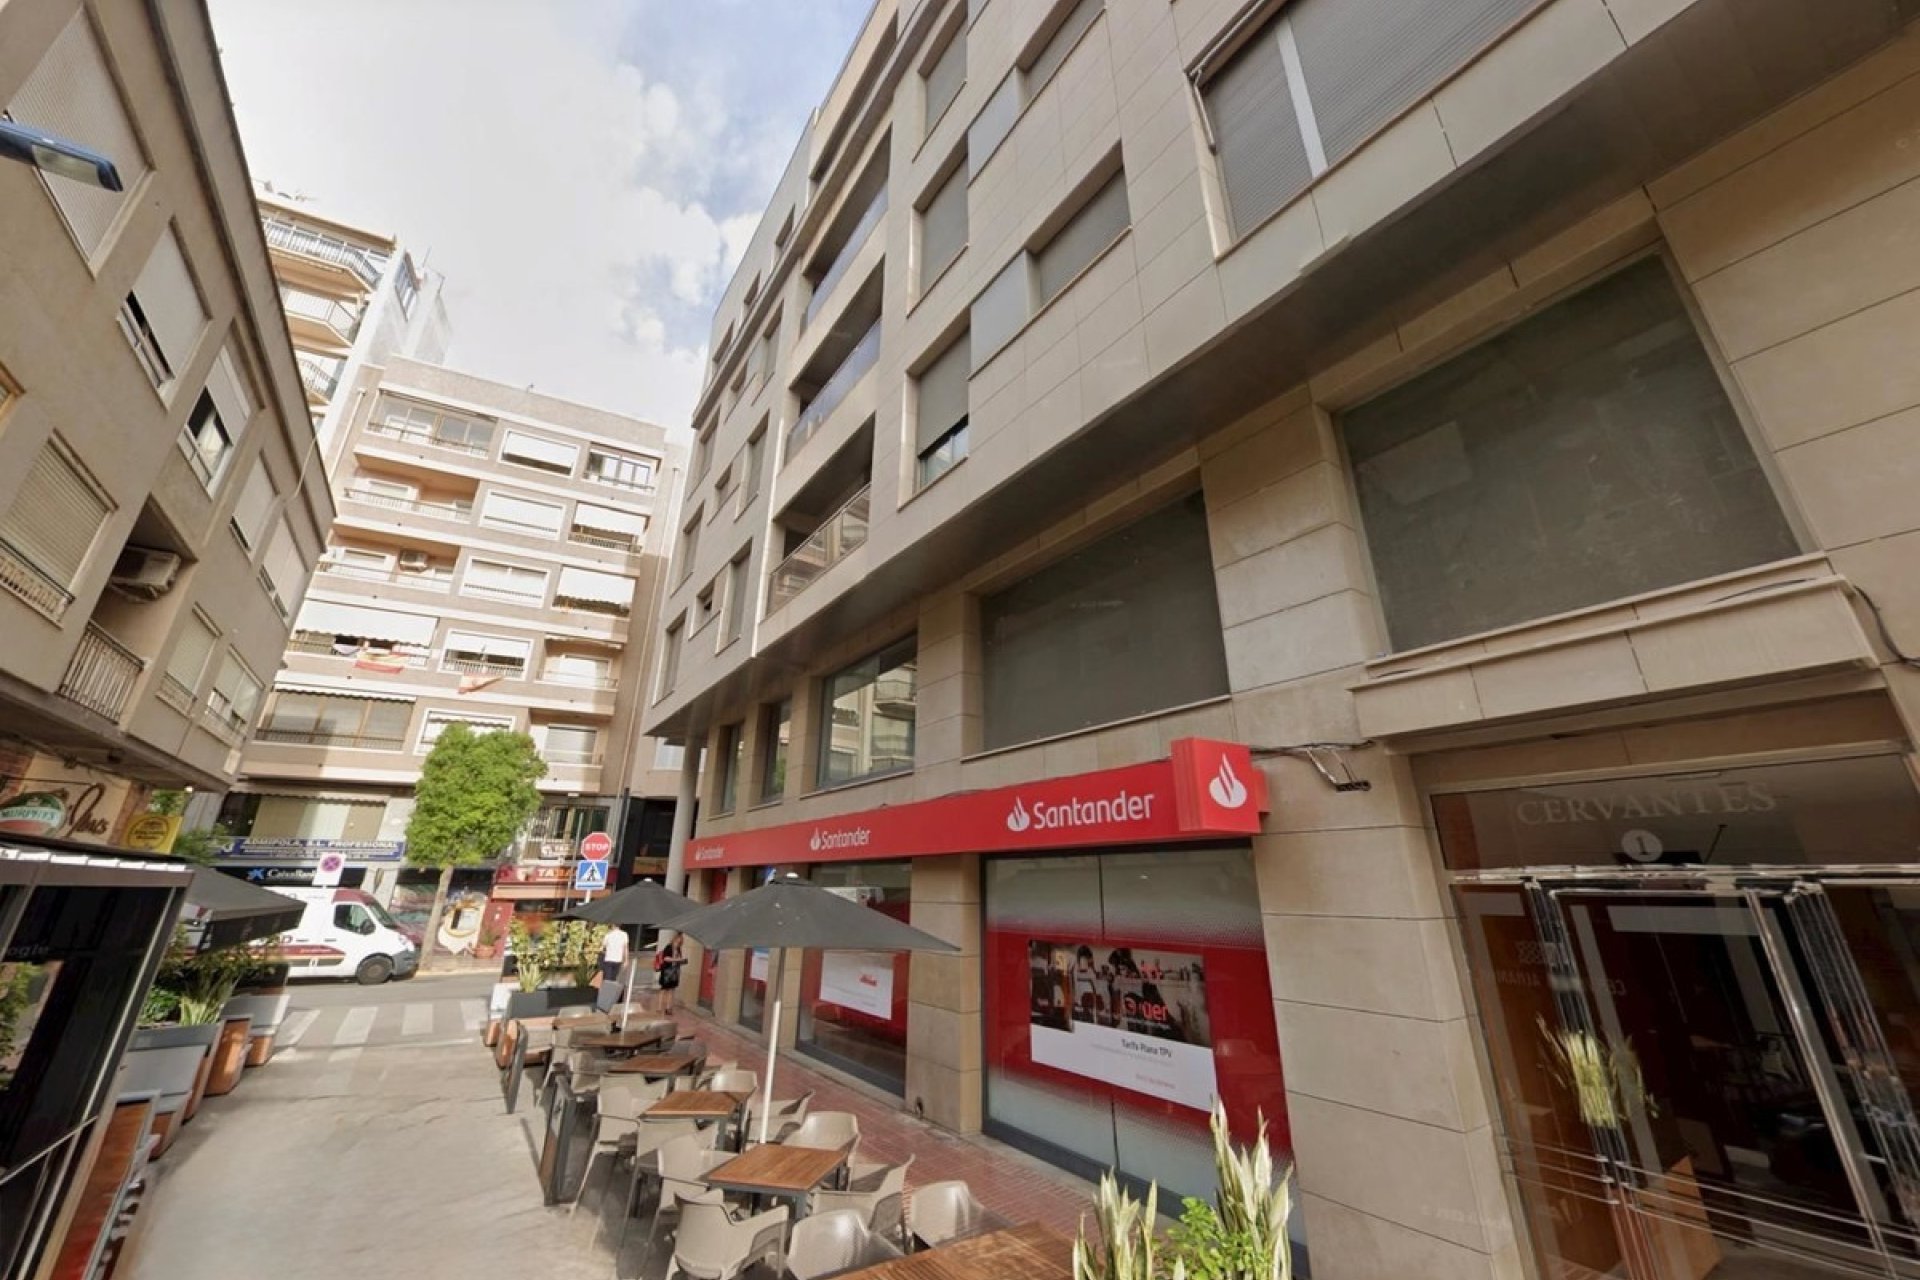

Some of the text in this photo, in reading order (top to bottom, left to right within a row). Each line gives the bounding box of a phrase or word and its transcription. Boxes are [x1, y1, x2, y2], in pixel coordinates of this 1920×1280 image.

[1033, 790, 1154, 829] Santander
[1516, 782, 1777, 825] CERVANTES
[584, 843, 609, 852] STOP
[821, 827, 871, 850] Santander
[1635, 836, 1649, 856] 1
